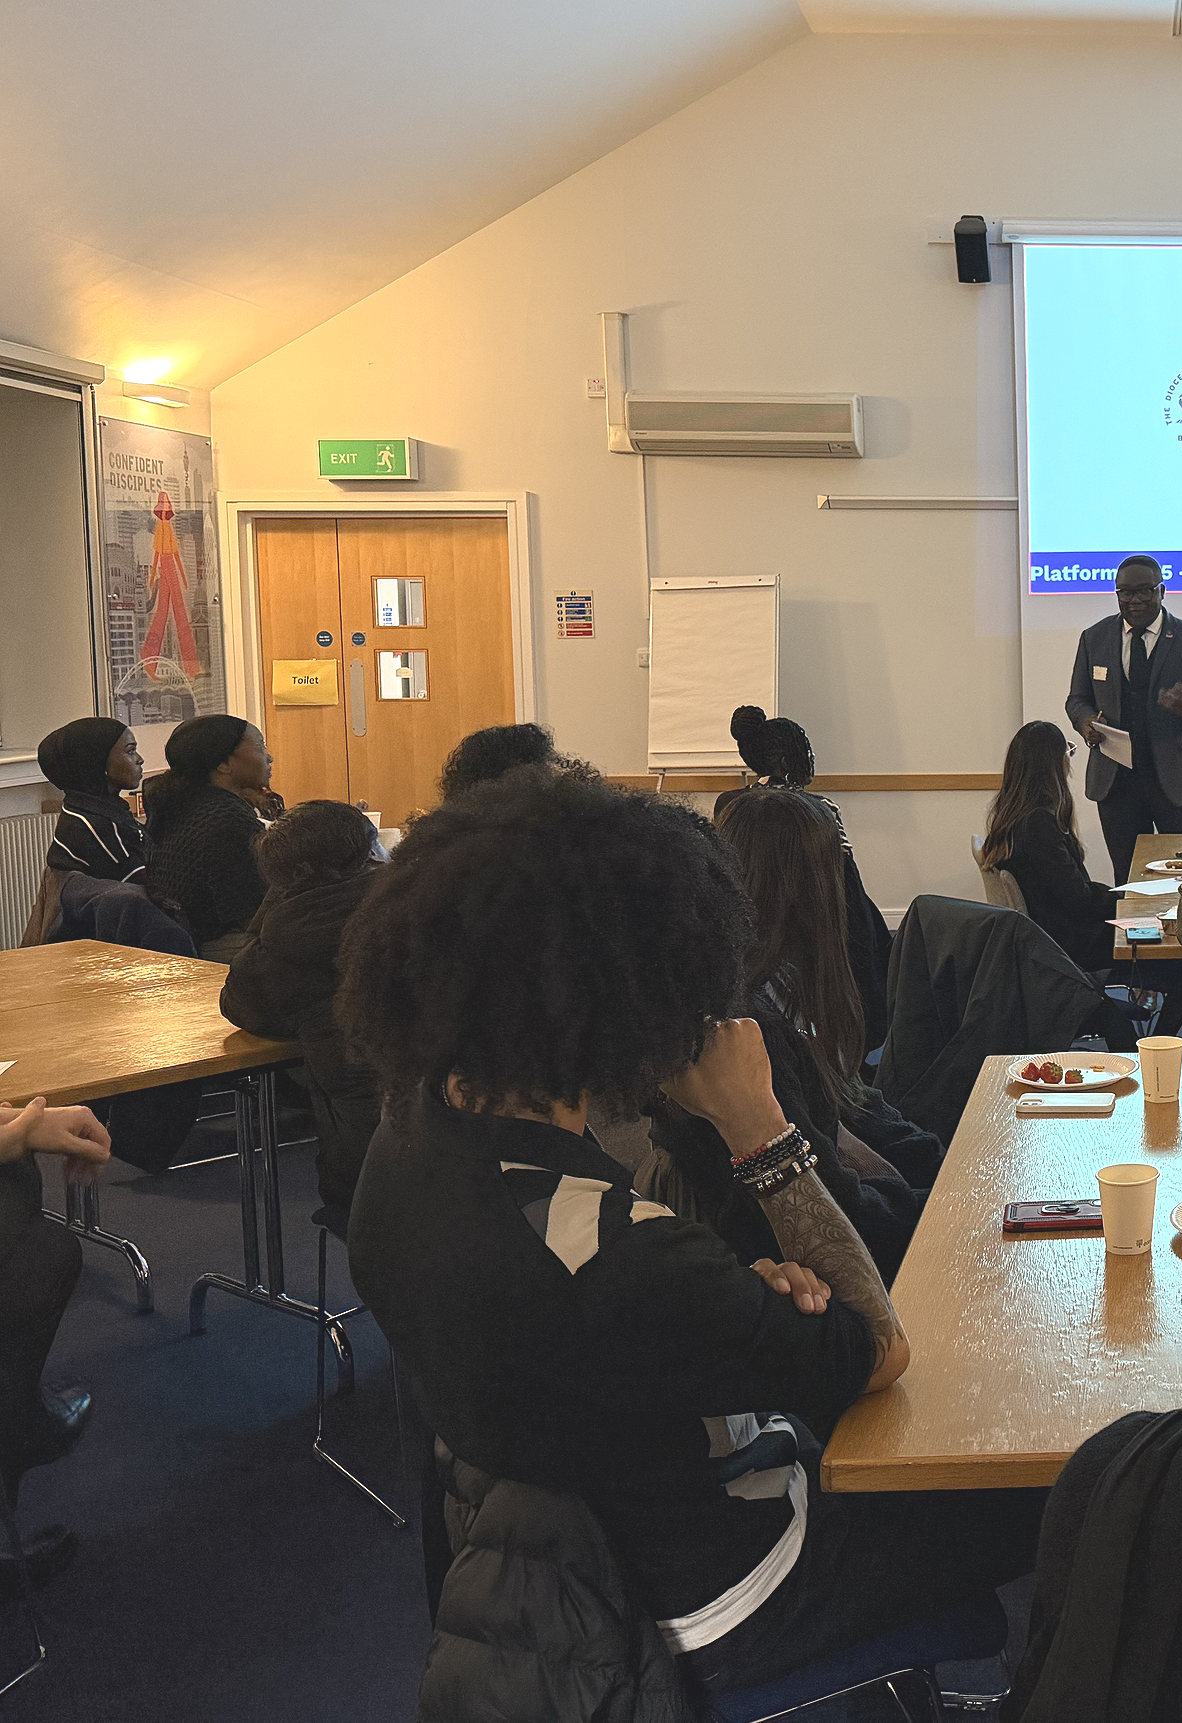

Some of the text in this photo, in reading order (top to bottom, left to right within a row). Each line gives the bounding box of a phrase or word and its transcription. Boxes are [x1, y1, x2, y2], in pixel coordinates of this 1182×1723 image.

[1164, 407, 1172, 426] THE
[108, 452, 164, 475] CONFIDENT
[330, 453, 358, 464] EXIT
[109, 471, 162, 494] DISCIPLES
[1031, 564, 1118, 581] Platform
[292, 675, 319, 684] Toilet
